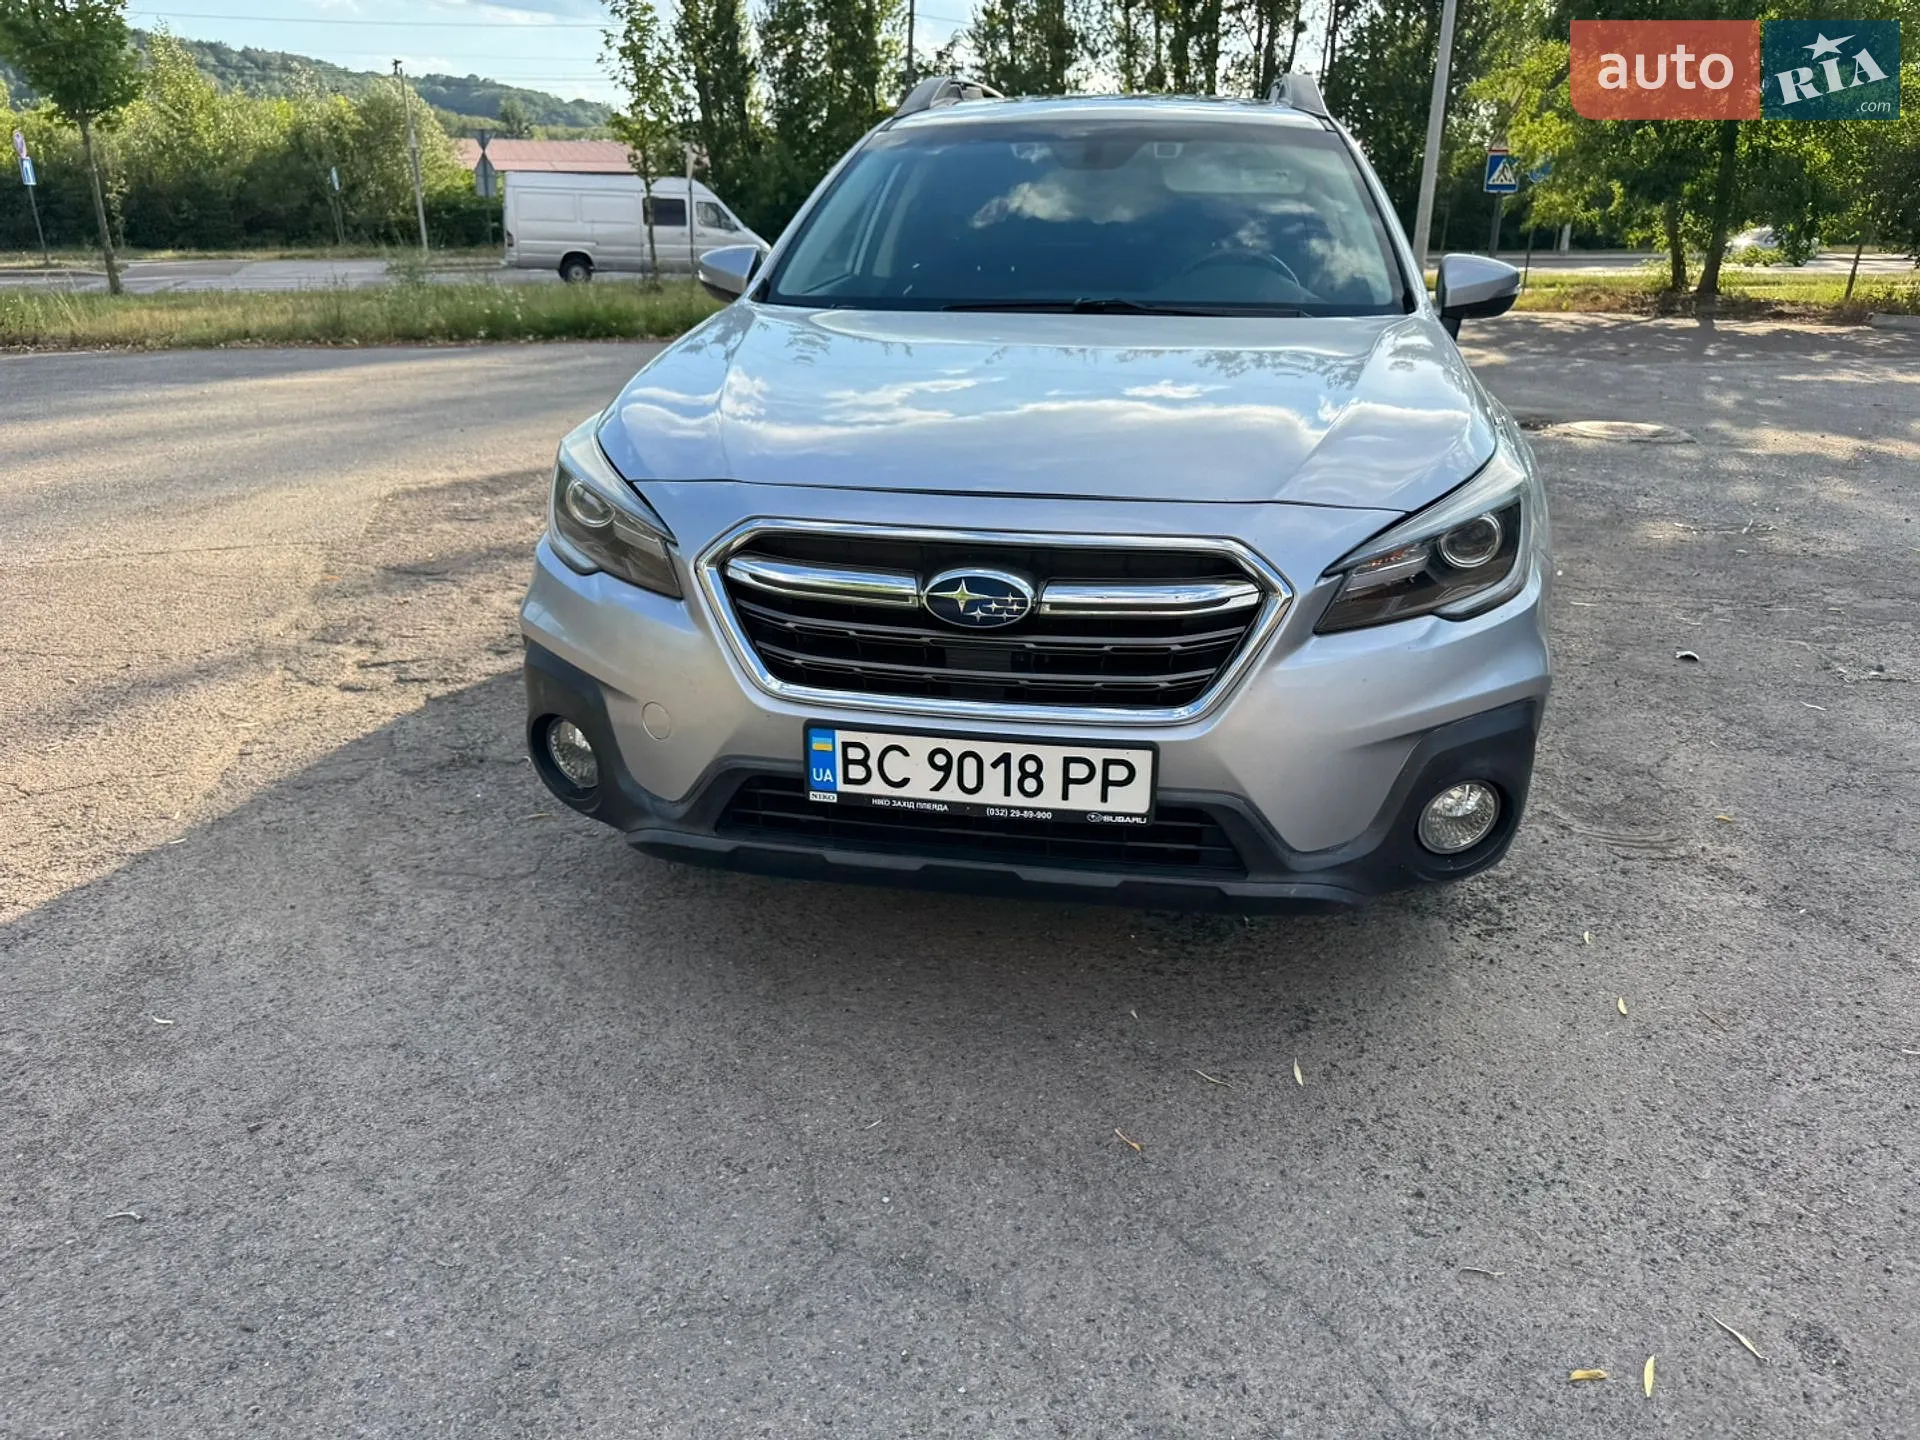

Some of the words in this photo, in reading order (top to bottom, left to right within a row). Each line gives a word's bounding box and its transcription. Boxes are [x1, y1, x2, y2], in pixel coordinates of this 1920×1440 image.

[812, 768, 834, 783] UA
[840, 741, 911, 788] BC
[927, 747, 1044, 799] 9018
[1061, 756, 1137, 803] PP
[986, 807, 1008, 817] (032)
[1101, 815, 1147, 825] SUBARU
